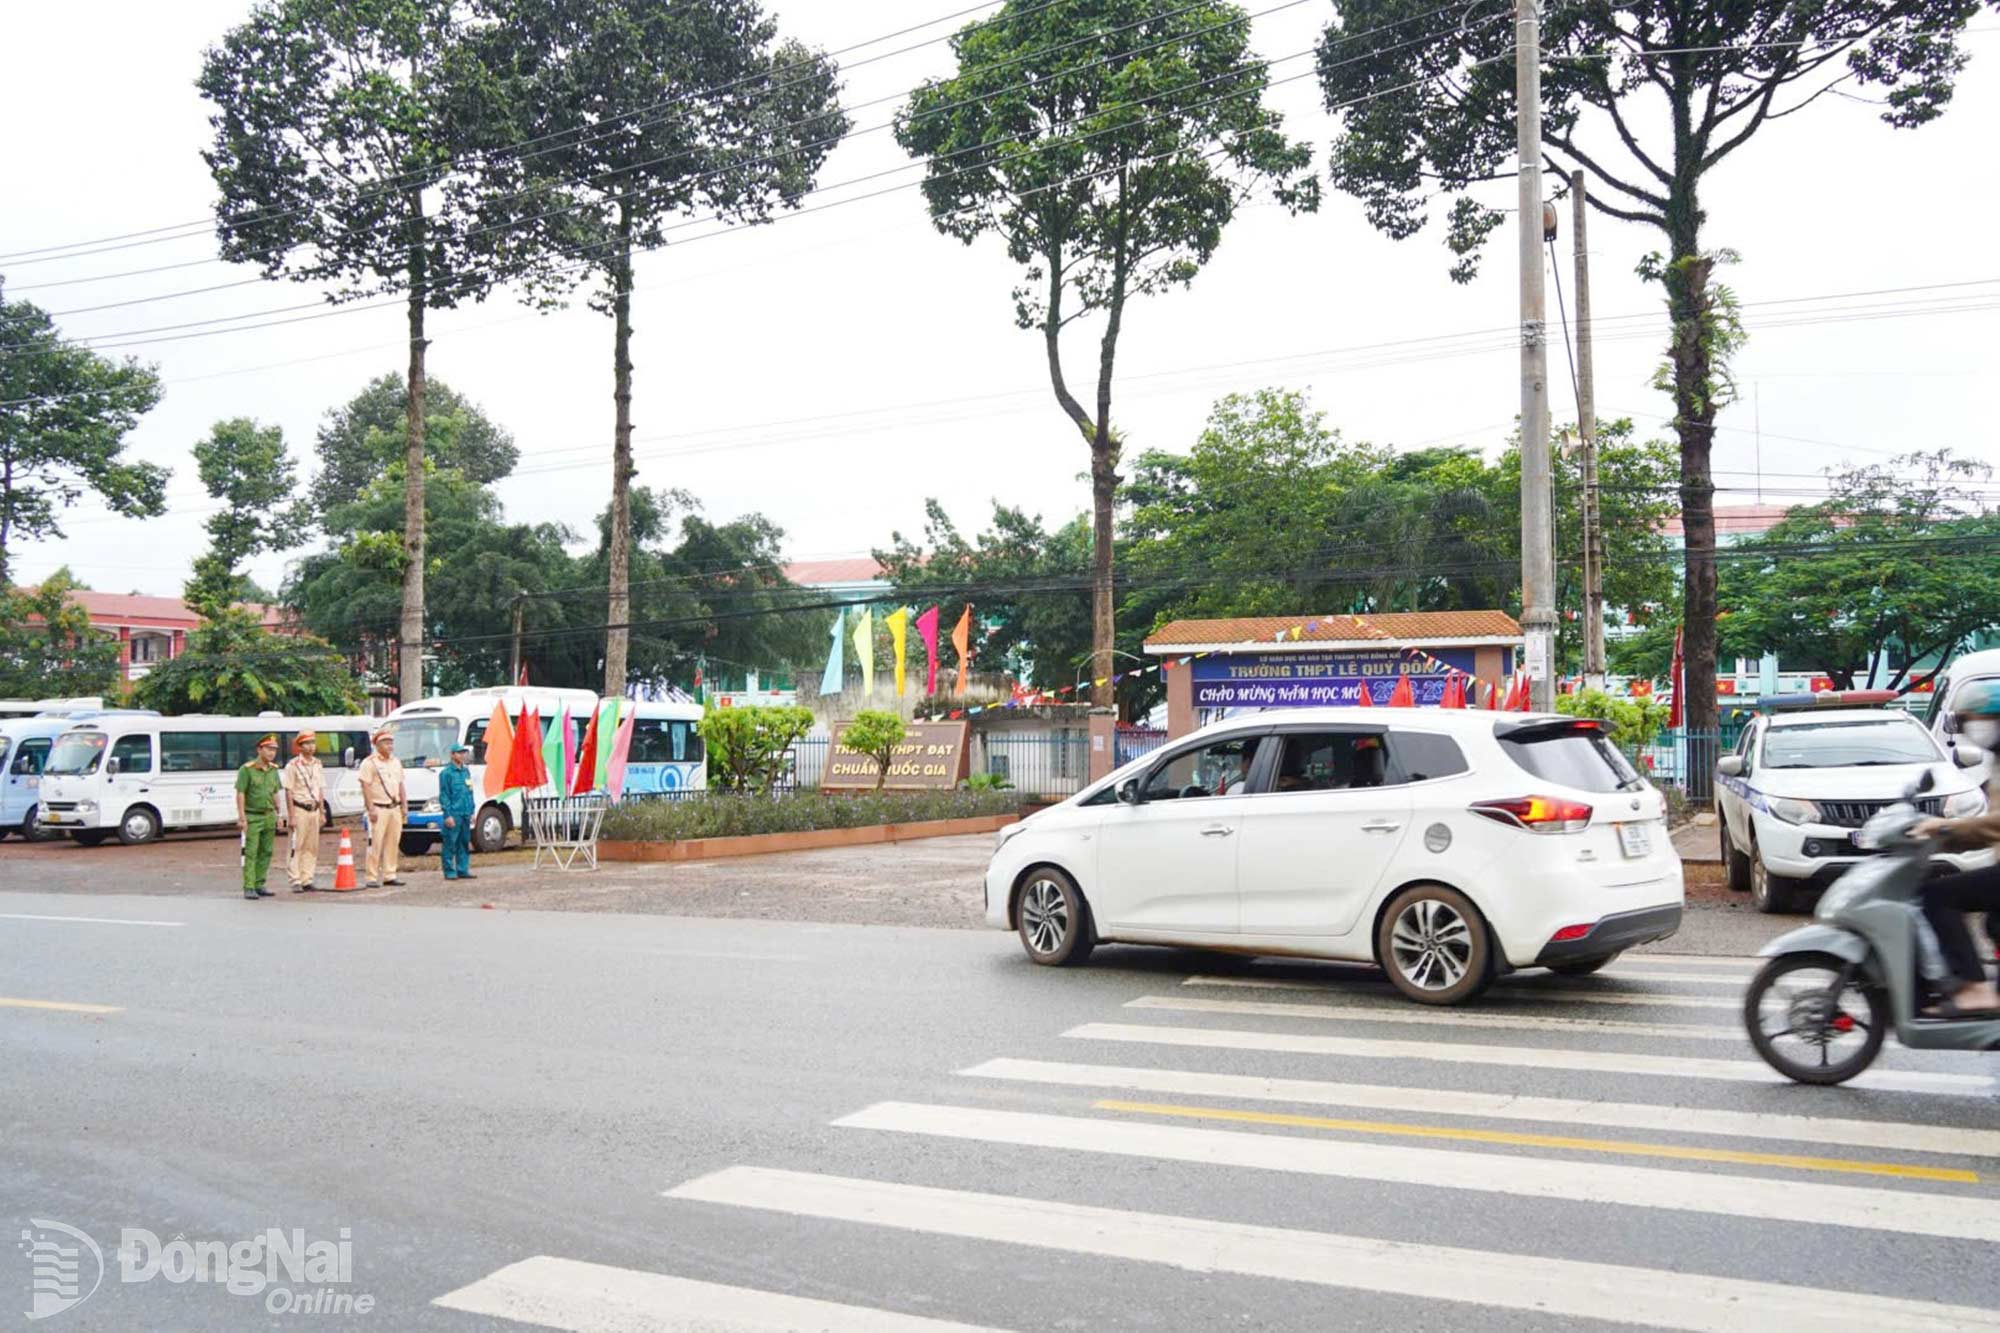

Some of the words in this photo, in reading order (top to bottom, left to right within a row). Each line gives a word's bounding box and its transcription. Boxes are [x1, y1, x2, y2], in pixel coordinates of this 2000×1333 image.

[1229, 663, 1292, 678] TRƯỜNG
[1295, 663, 1335, 677] THPT
[1338, 660, 1358, 676] LÊ
[1361, 660, 1394, 675] QUÝ
[1199, 684, 1236, 703] CHÀO
[1236, 683, 1276, 704] MỪNG
[1277, 684, 1309, 702] NĂM
[1310, 685, 1340, 703] HỌC
[927, 744, 955, 759] ĐẠT
[831, 758, 880, 776] CHUẨN
[886, 759, 921, 776] UỐC
[923, 763, 947, 776] GIA
